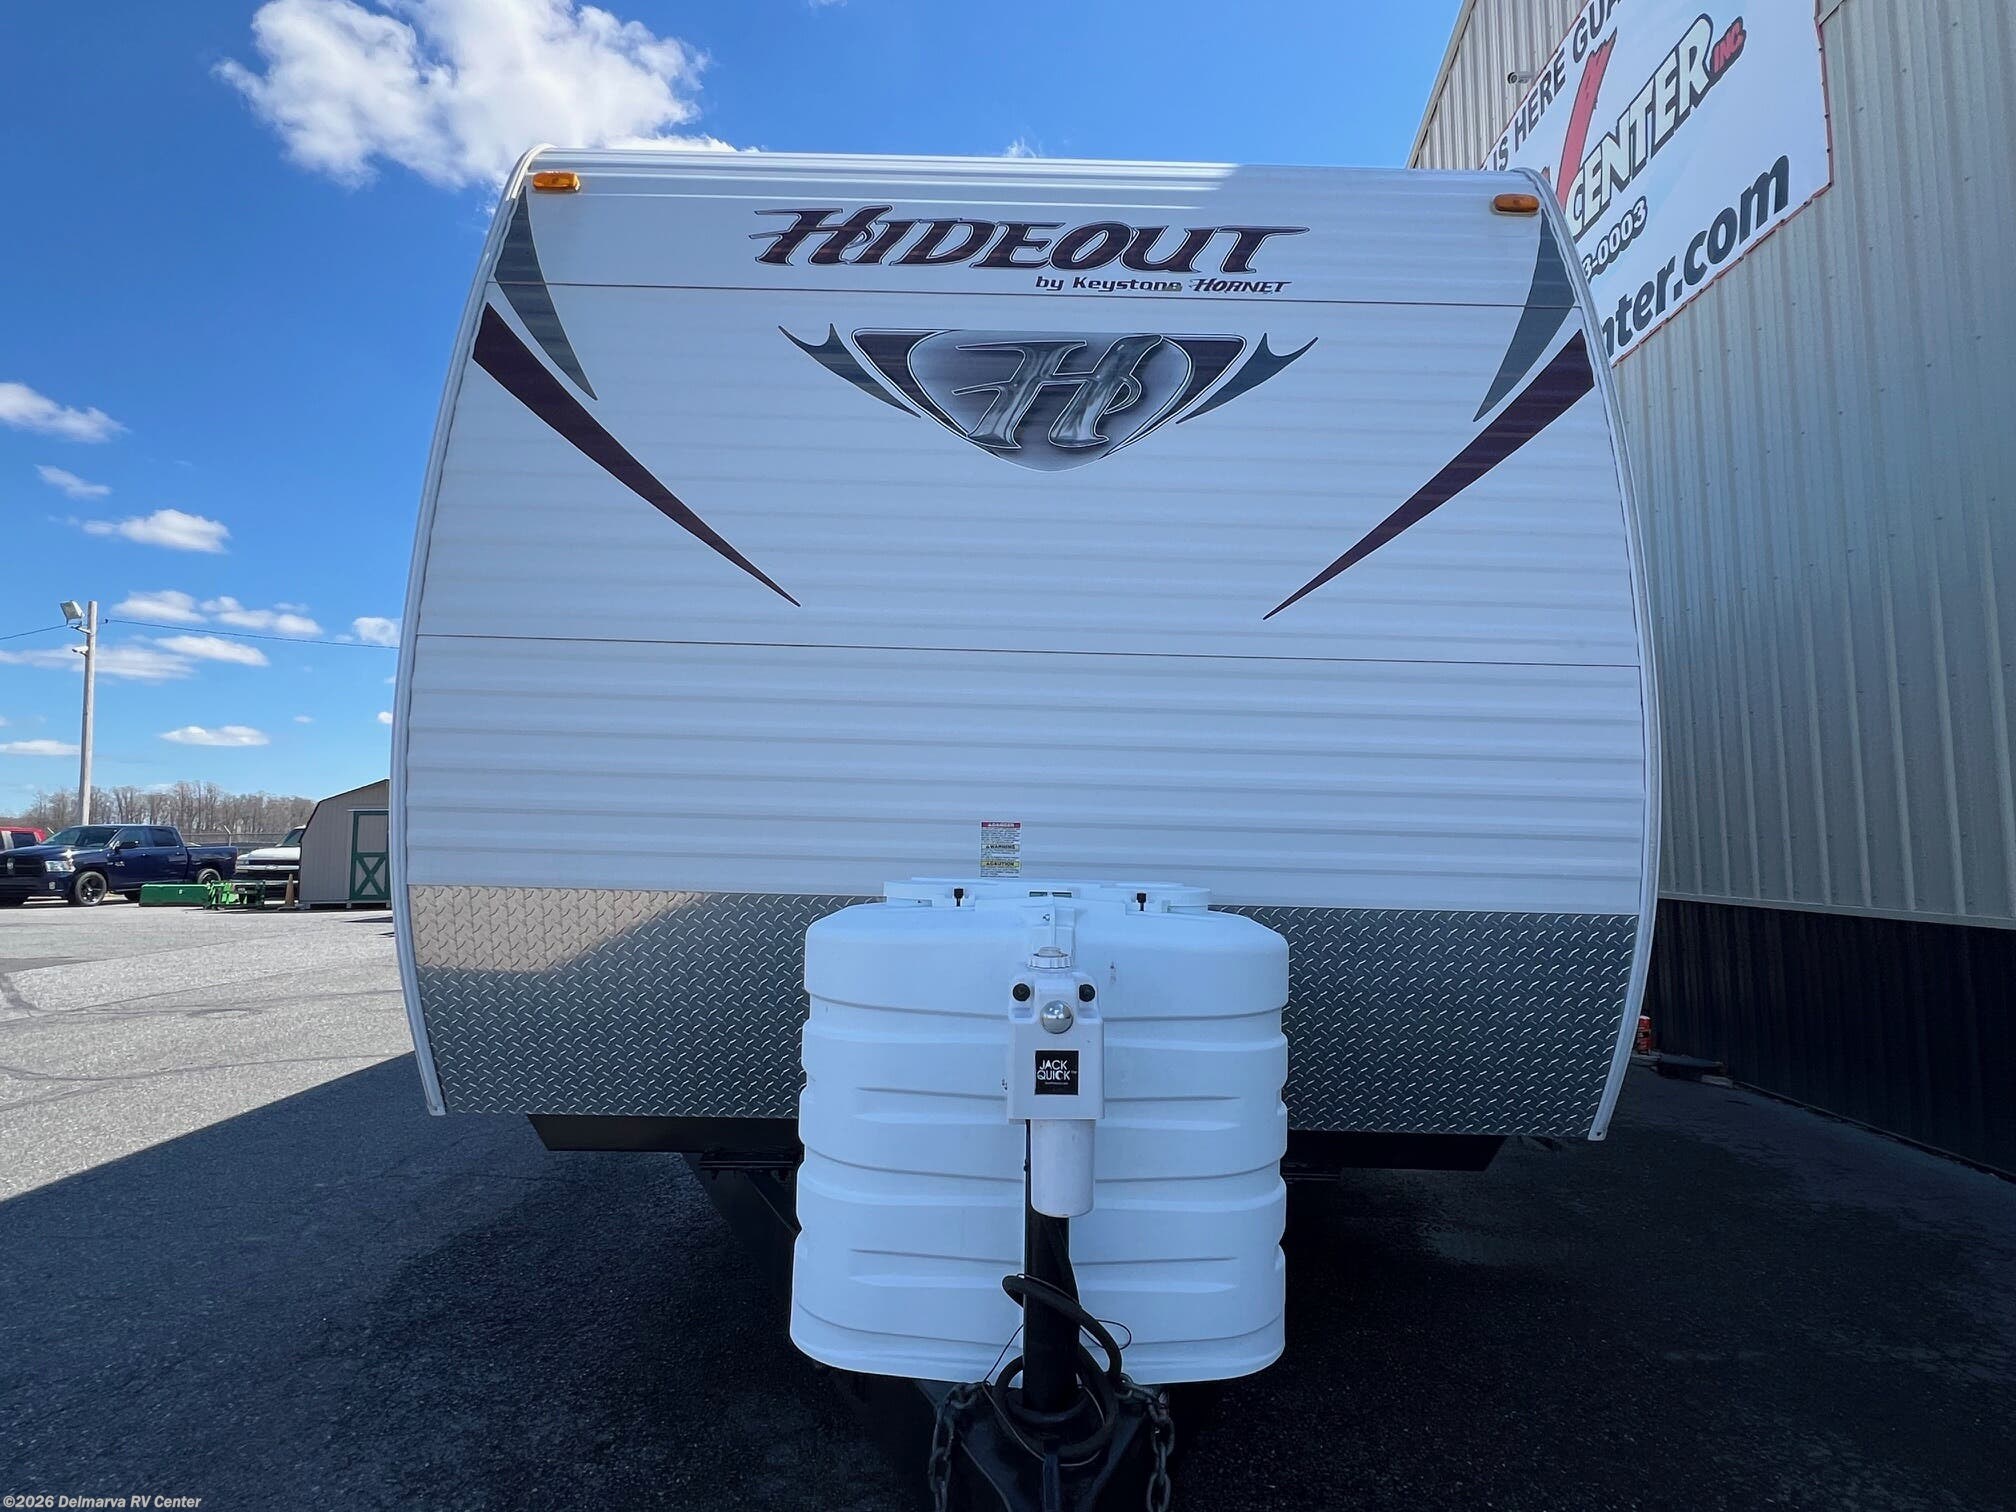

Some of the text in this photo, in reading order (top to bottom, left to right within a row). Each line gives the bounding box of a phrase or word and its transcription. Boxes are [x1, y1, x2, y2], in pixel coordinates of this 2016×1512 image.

[1514, 48, 1566, 152] HERE
[1565, 13, 1714, 241] CENTER
[749, 204, 1310, 274] HIDEOUT
[1035, 276, 1292, 293] by Keystone HORNET
[1037, 1070, 1071, 1081] QUICK
[1039, 1059, 1068, 1070] JACK
